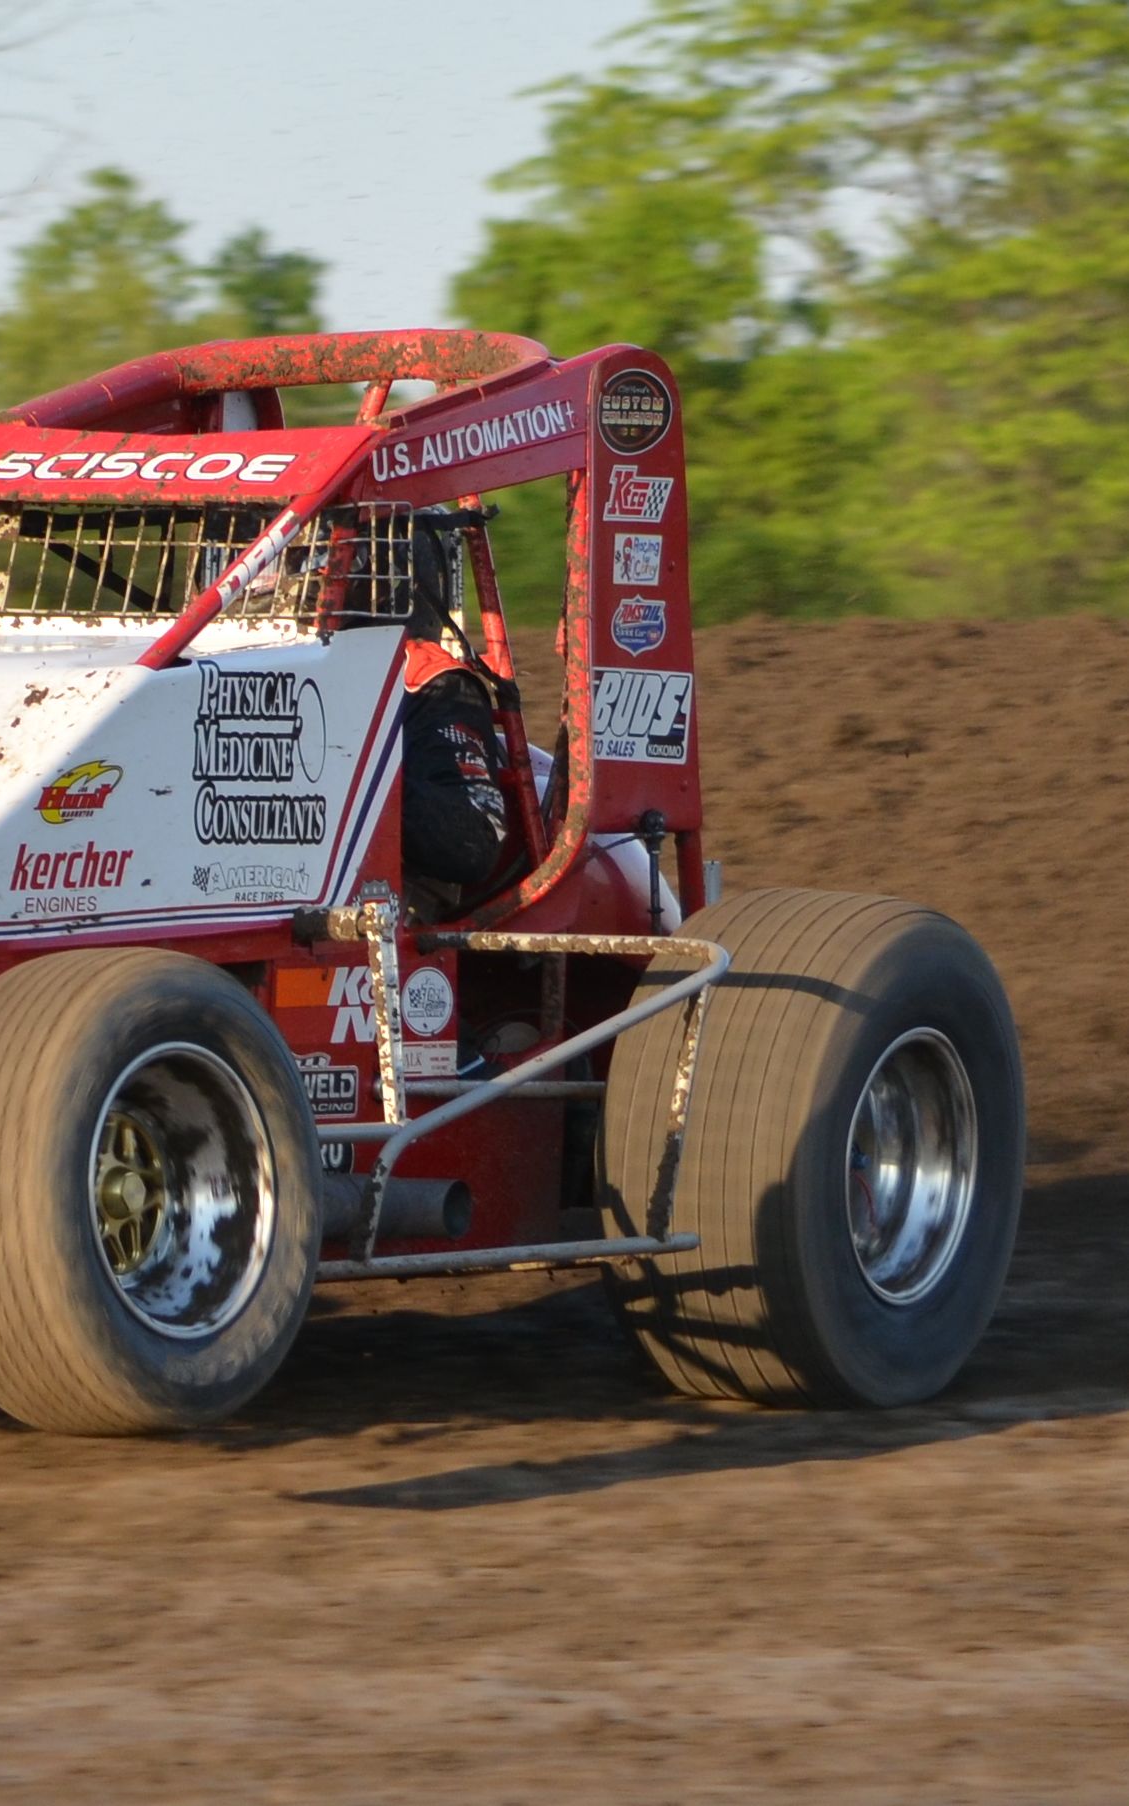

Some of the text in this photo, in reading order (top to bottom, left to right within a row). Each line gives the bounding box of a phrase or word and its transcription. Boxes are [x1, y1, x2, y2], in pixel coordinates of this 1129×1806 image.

[602, 395, 664, 411] CUSTOM
[372, 442, 418, 482] U.S.
[620, 604, 661, 623] AMSOIL
[198, 660, 296, 720] PHYSICAL
[194, 720, 294, 781] MEDICINE
[606, 739, 636, 758] SALES
[647, 743, 682, 758] KOKOMO
[195, 781, 326, 845] CONSULTANTS
[10, 841, 134, 891] kercher
[25, 896, 97, 913] ENGINES
[234, 891, 285, 903] RACE TIRES
